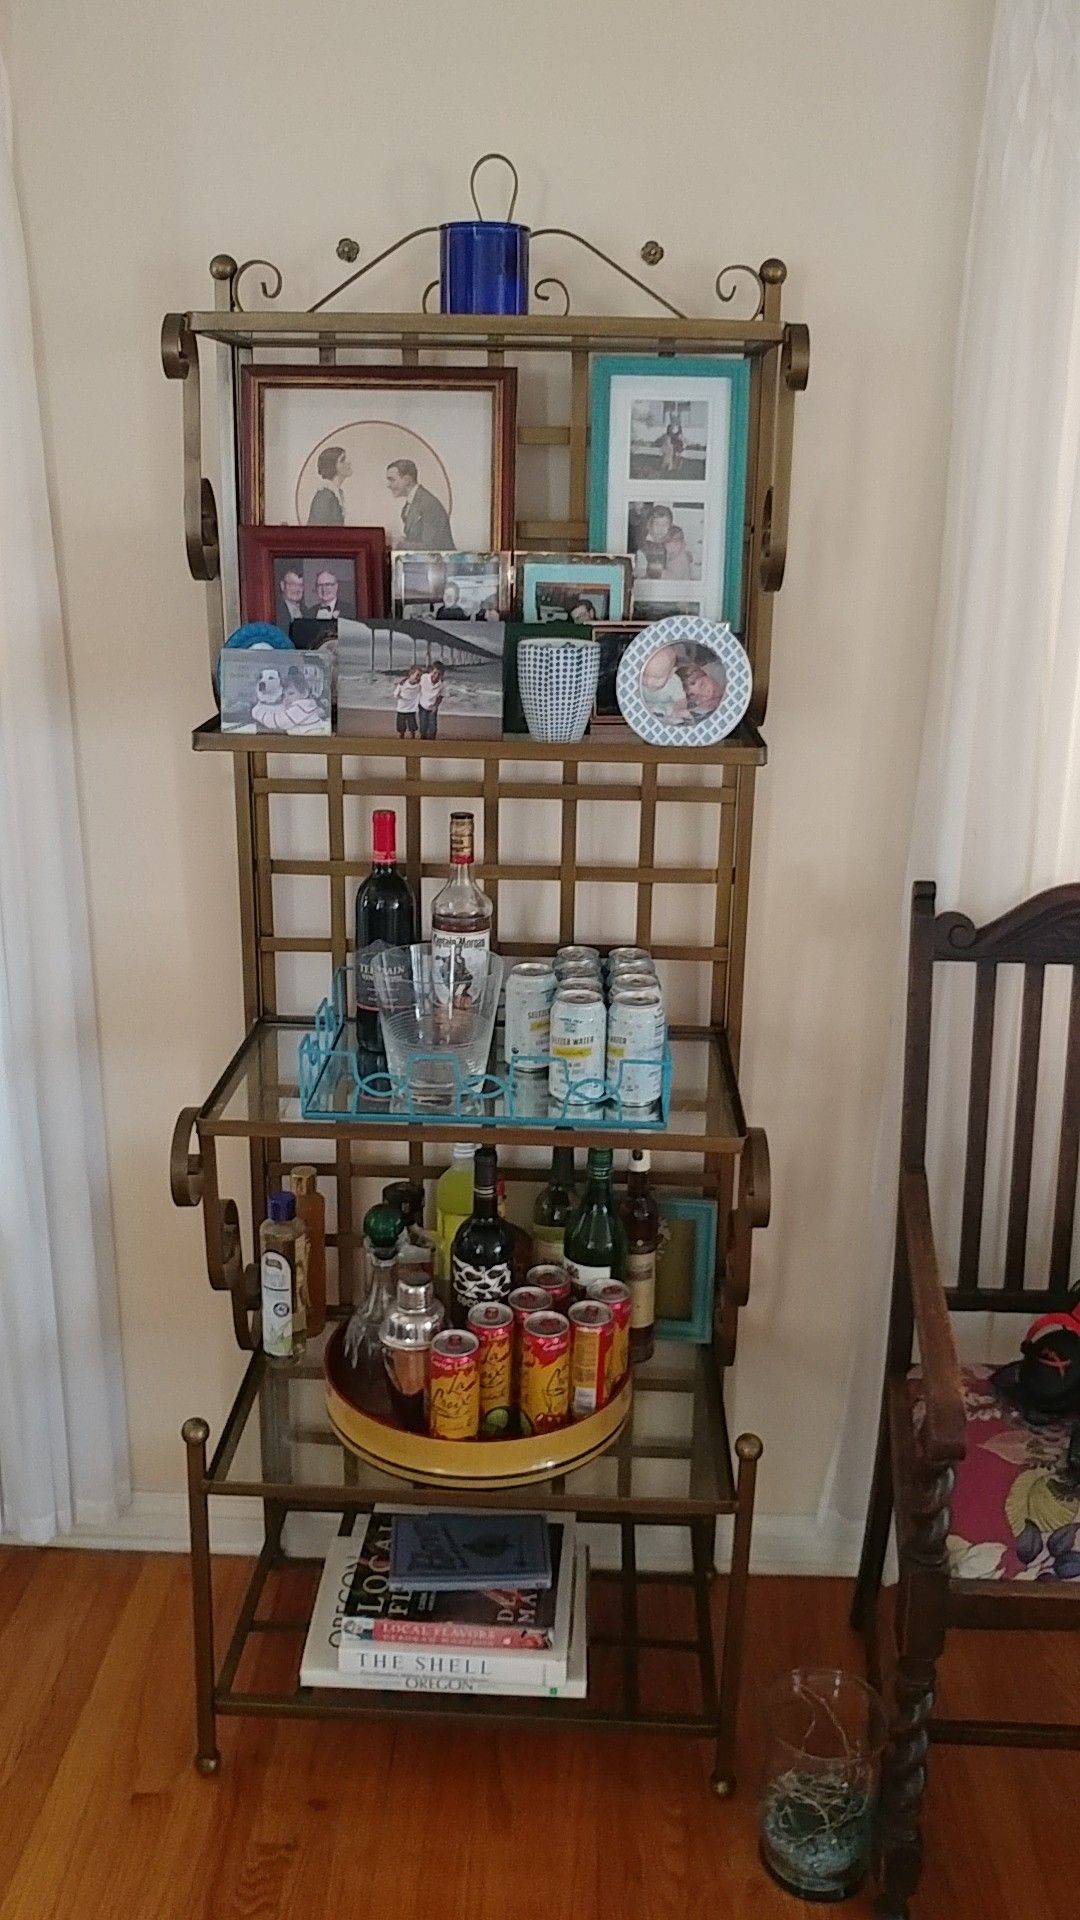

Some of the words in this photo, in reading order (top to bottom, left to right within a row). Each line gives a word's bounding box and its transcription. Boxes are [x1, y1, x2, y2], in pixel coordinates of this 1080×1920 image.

[382, 1623, 427, 1636] LOCAL
[357, 1653, 404, 1669] THE
[416, 1656, 493, 1674] SHELL
[404, 1676, 475, 1692] OREGON
